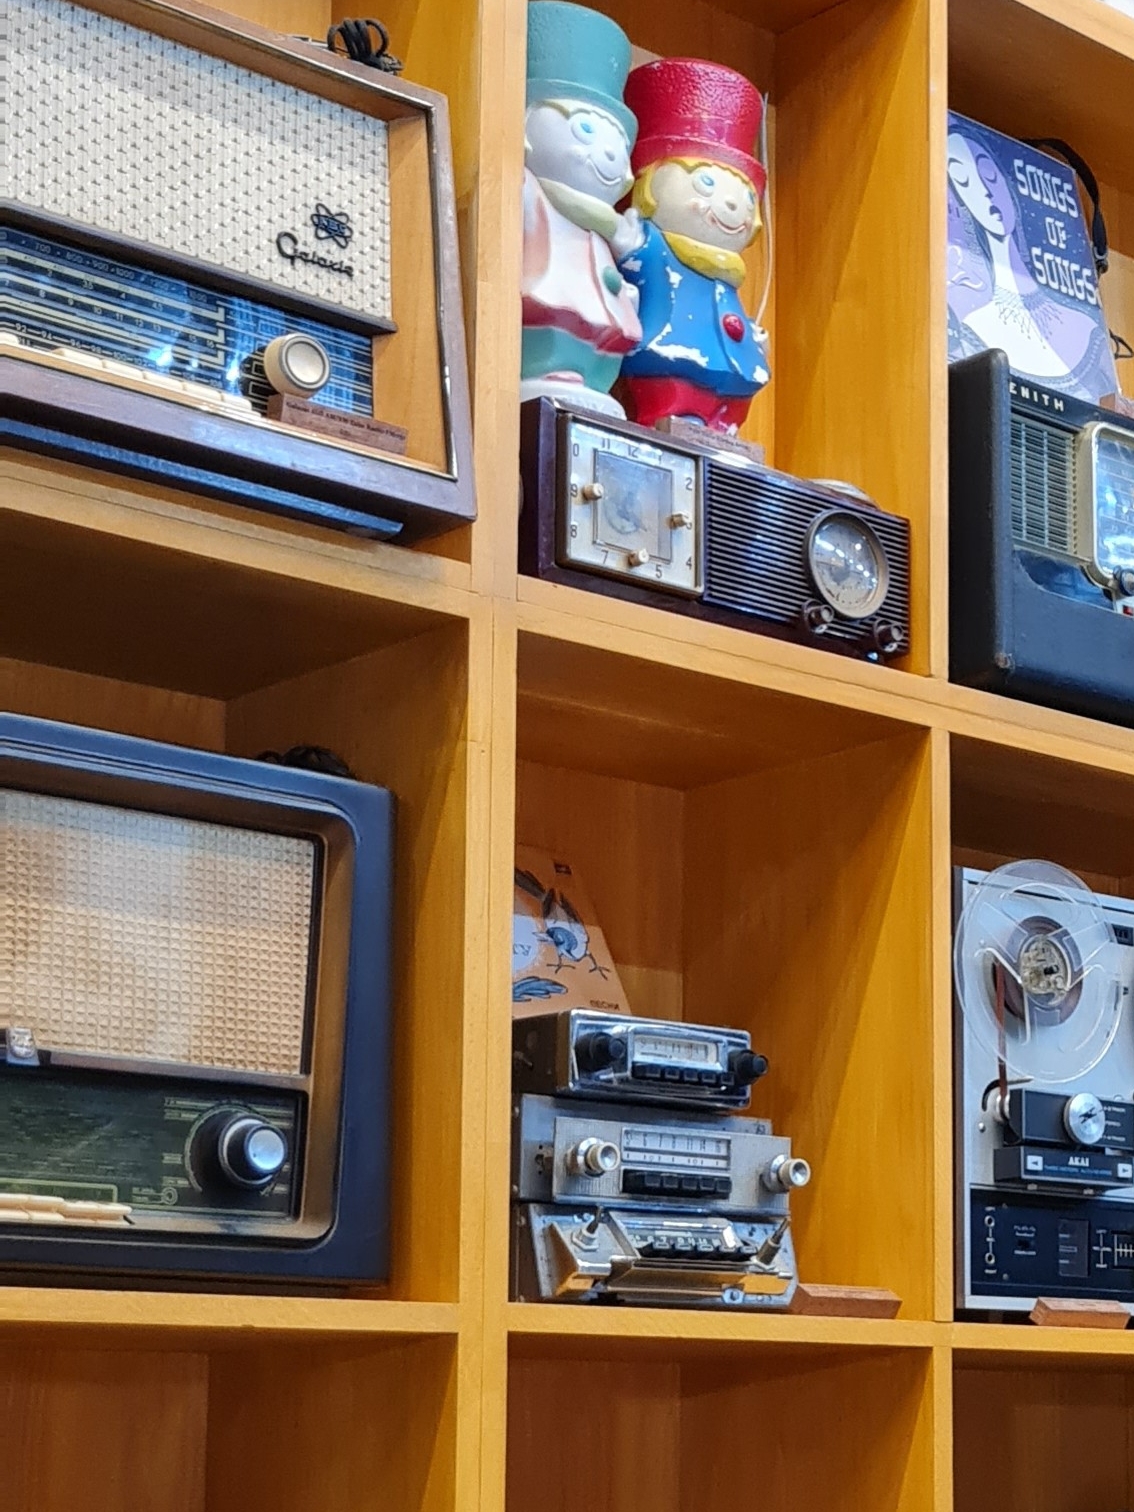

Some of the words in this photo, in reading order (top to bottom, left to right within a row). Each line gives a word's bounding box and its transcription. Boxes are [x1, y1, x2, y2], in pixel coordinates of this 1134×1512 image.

[1014, 159, 1078, 218] SONGS
[1045, 217, 1066, 249] OF
[1031, 247, 1097, 305] SONGS
[1009, 381, 1064, 412] ENITH
[628, 446, 638, 459] 12
[571, 483, 578, 498] 9
[685, 477, 693, 492] 2
[570, 525, 578, 538] 8
[601, 550, 609, 564] 7
[685, 556, 693, 570] 4
[655, 565, 663, 579] 5
[1068, 1156, 1090, 1167] AKAI
